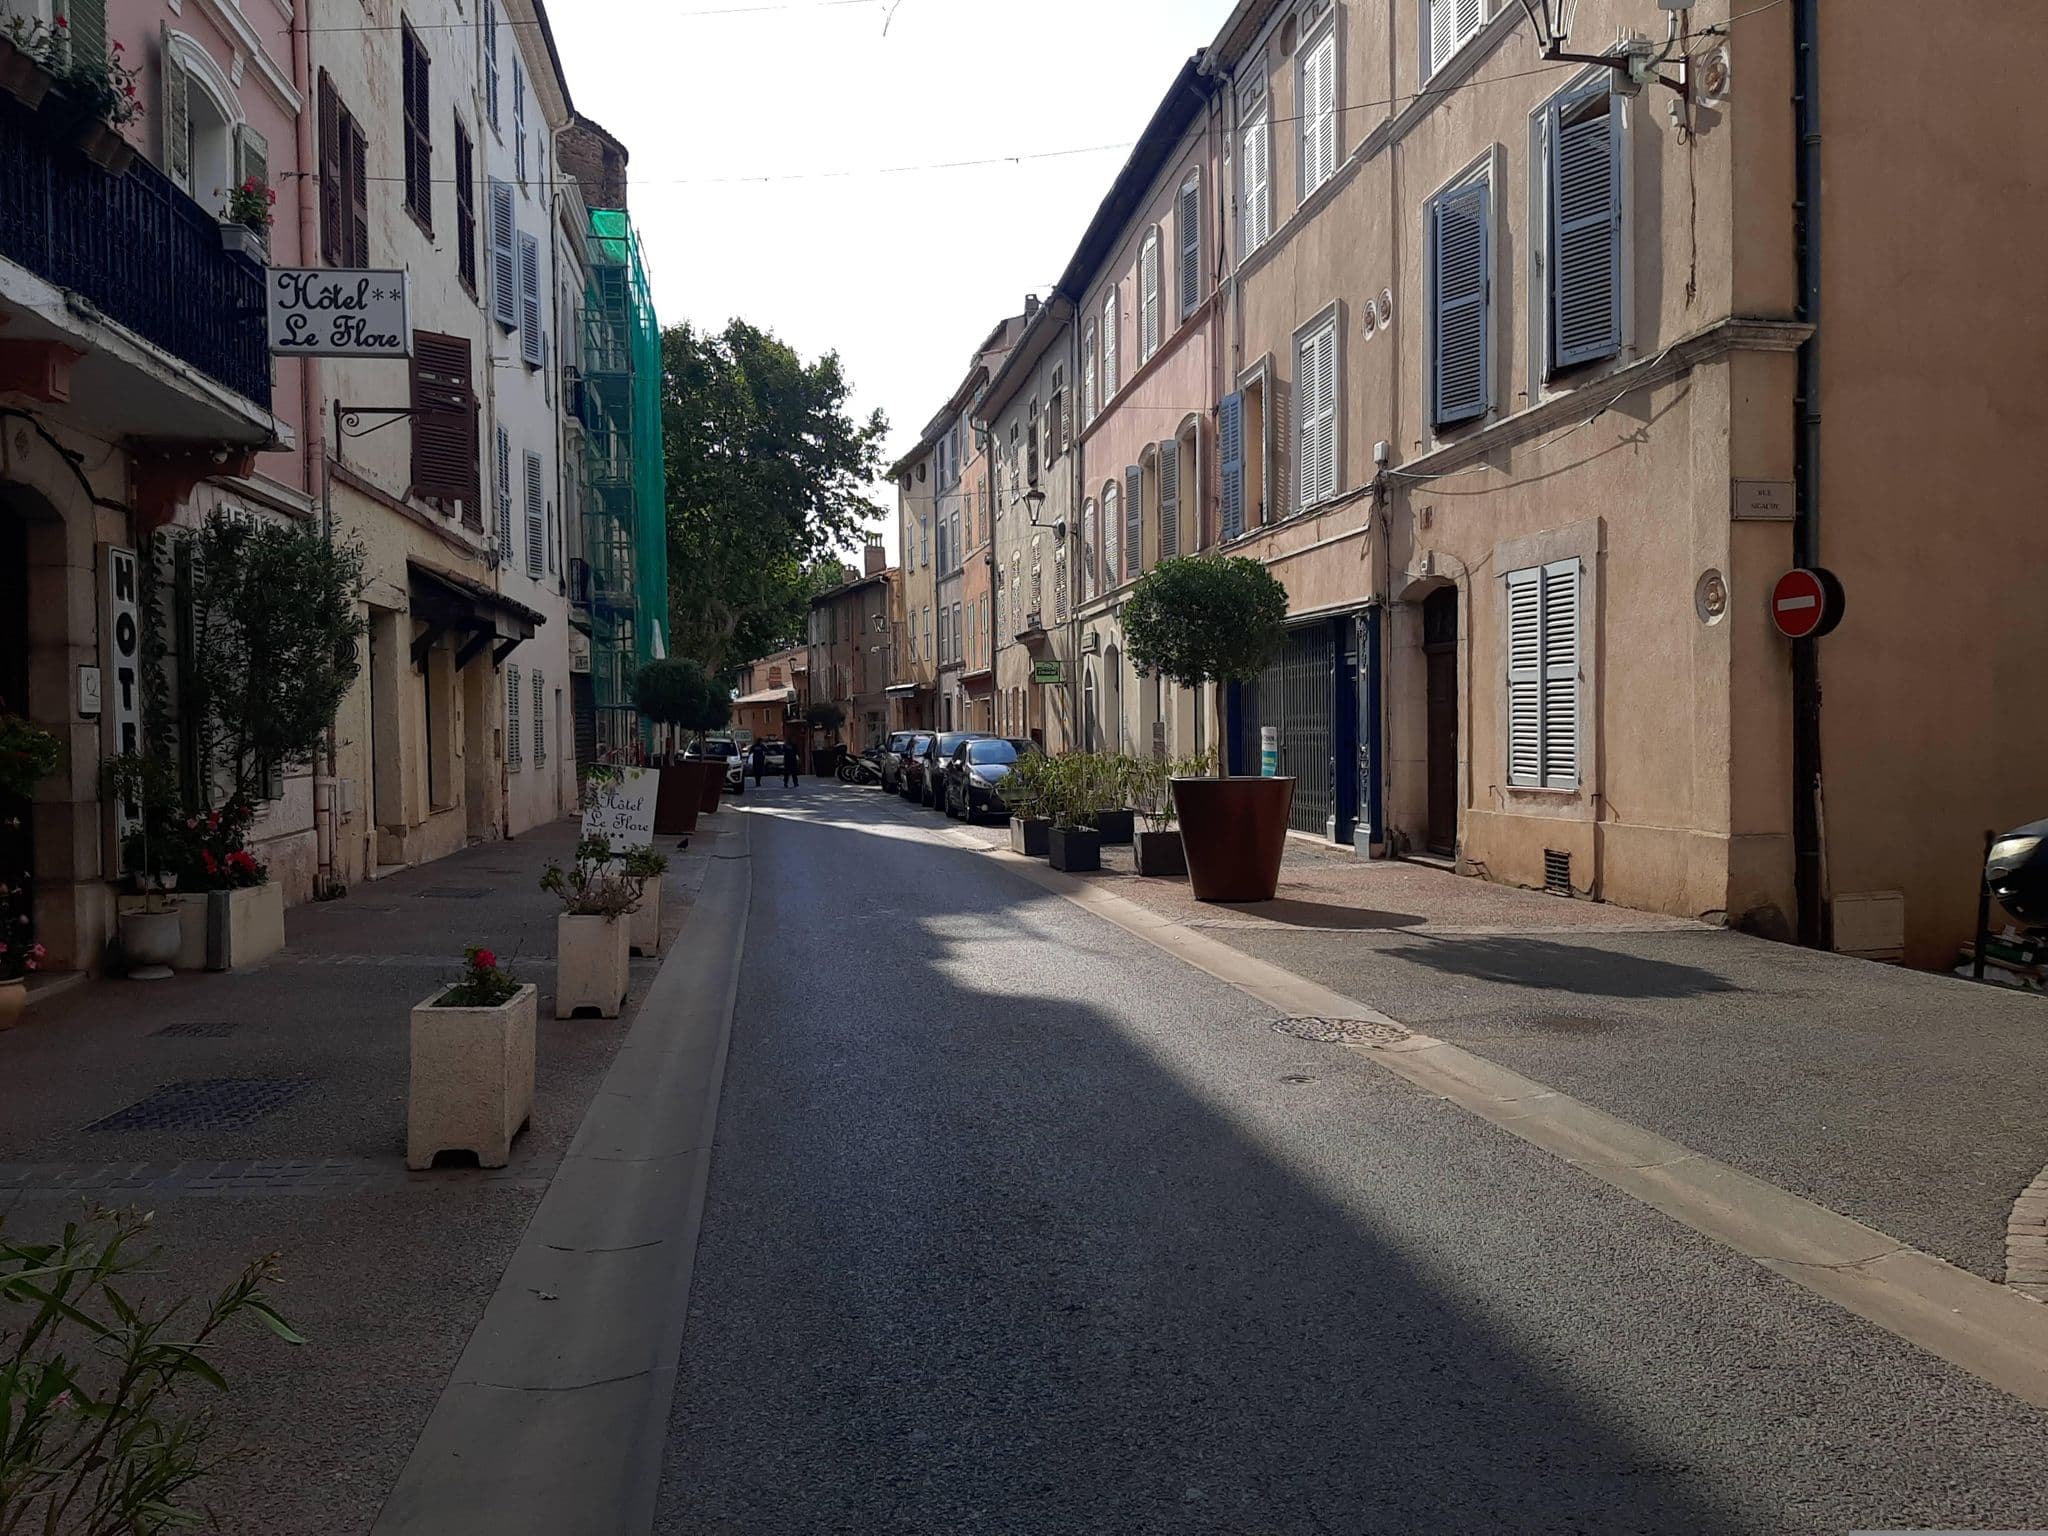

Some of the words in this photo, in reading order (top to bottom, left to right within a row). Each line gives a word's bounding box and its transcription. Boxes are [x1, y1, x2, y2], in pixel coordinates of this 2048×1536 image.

[277, 273, 370, 310] Hôtel
[279, 313, 319, 347] Le
[330, 315, 401, 347] Flore
[586, 811, 606, 828] Le
[612, 813, 649, 832] Flore
